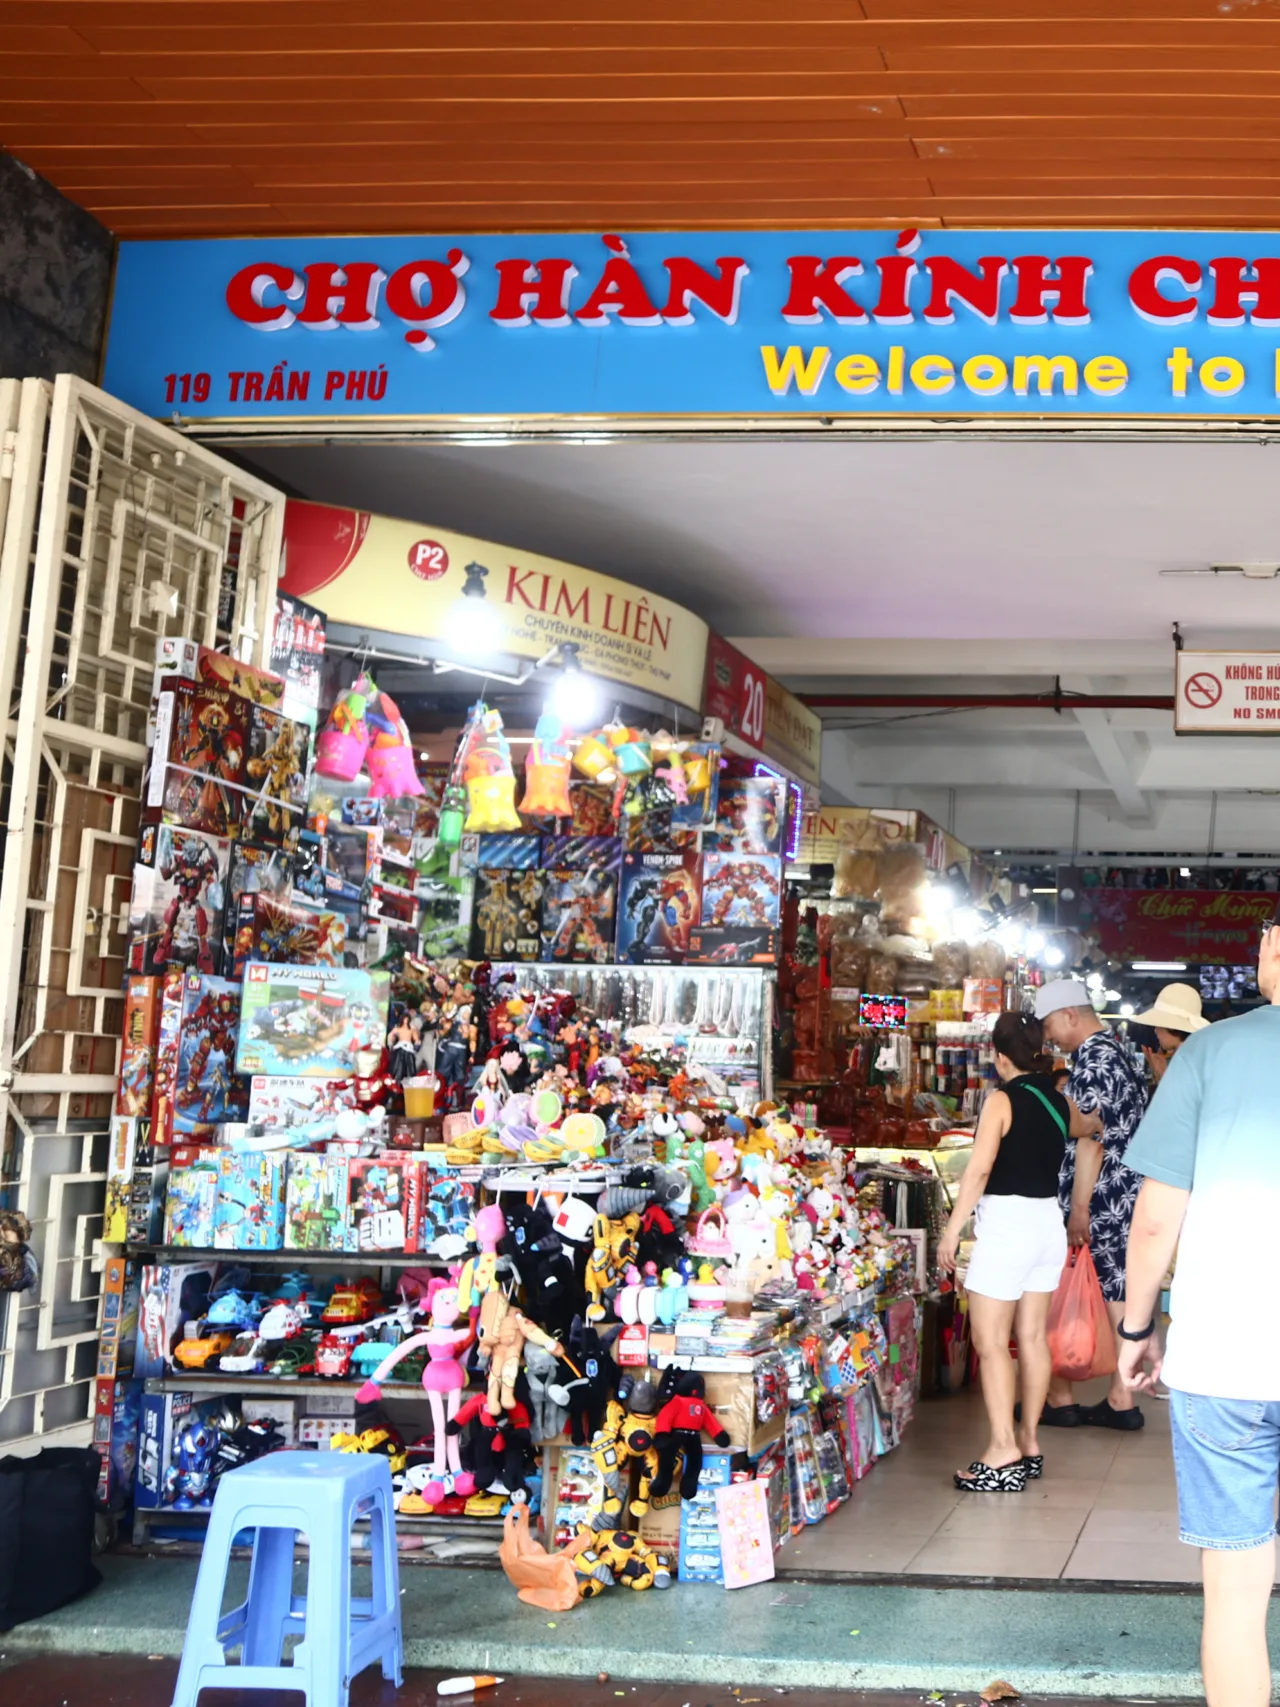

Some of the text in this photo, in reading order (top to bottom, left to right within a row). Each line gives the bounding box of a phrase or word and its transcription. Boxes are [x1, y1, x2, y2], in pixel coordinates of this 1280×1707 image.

[226, 248, 470, 351] CHỢ
[489, 234, 749, 327] HÀN
[780, 227, 1094, 326] KÍNH
[164, 359, 389, 403] 119 TRẦN PHÚ
[760, 345, 1129, 397] Welcome
[1167, 346, 1246, 397] to
[415, 543, 445, 570] P2
[505, 565, 673, 652] KIM LIÊN
[1225, 663, 1263, 680] KHÔNG
[1244, 686, 1280, 701] TRONG
[740, 672, 764, 742] 20
[1233, 708, 1251, 719] NO
